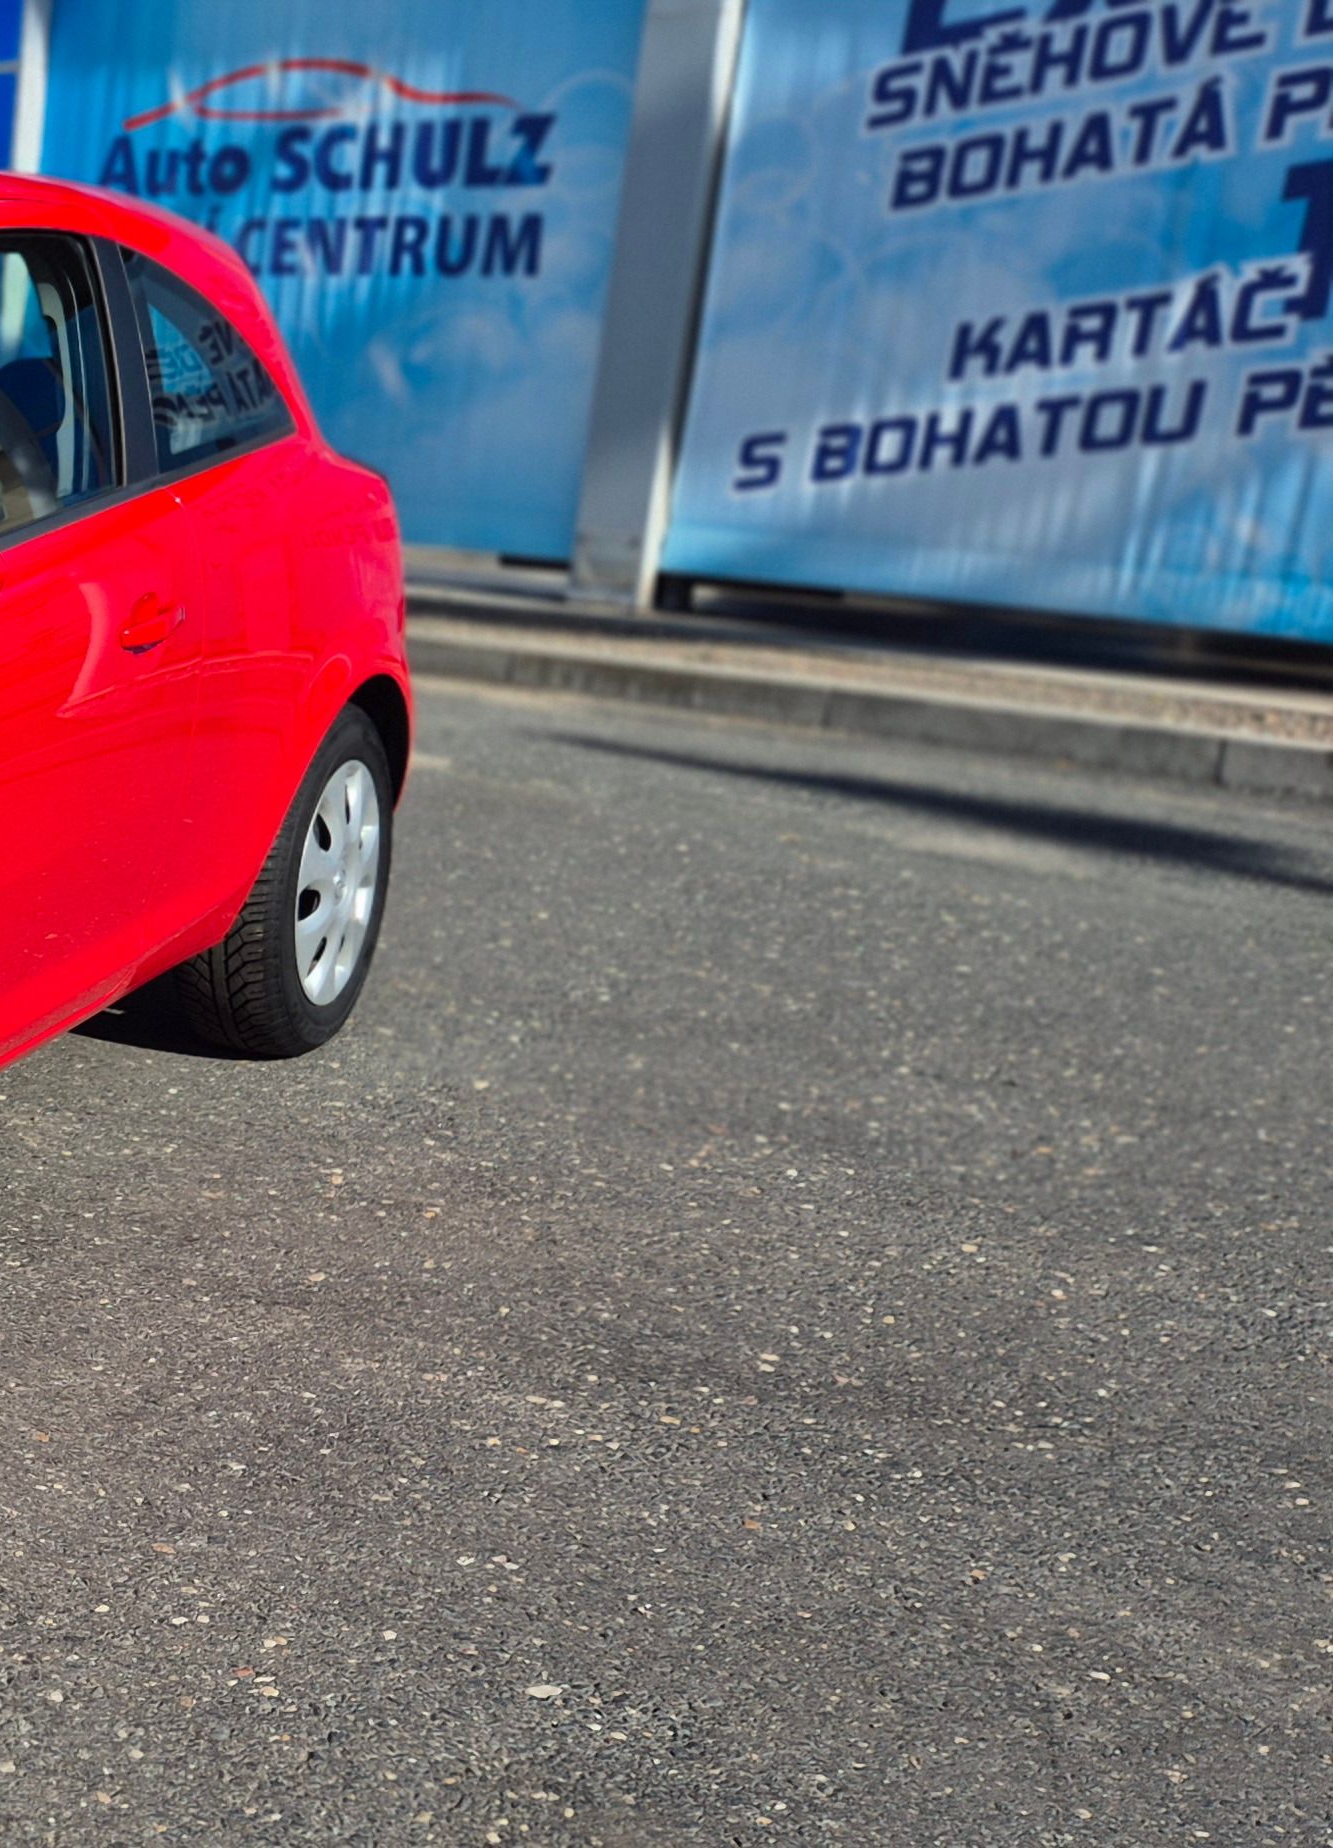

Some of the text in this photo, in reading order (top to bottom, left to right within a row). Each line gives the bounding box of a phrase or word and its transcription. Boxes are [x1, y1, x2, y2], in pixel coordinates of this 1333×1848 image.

[99, 112, 558, 197] Auto SCHULZ
[890, 65, 1333, 211] BOHATÁ P
[237, 212, 544, 279] CENTRUM
[947, 264, 1300, 383] KARTÁČ
[733, 430, 787, 491] S
[811, 379, 1207, 485] BOHATOU
